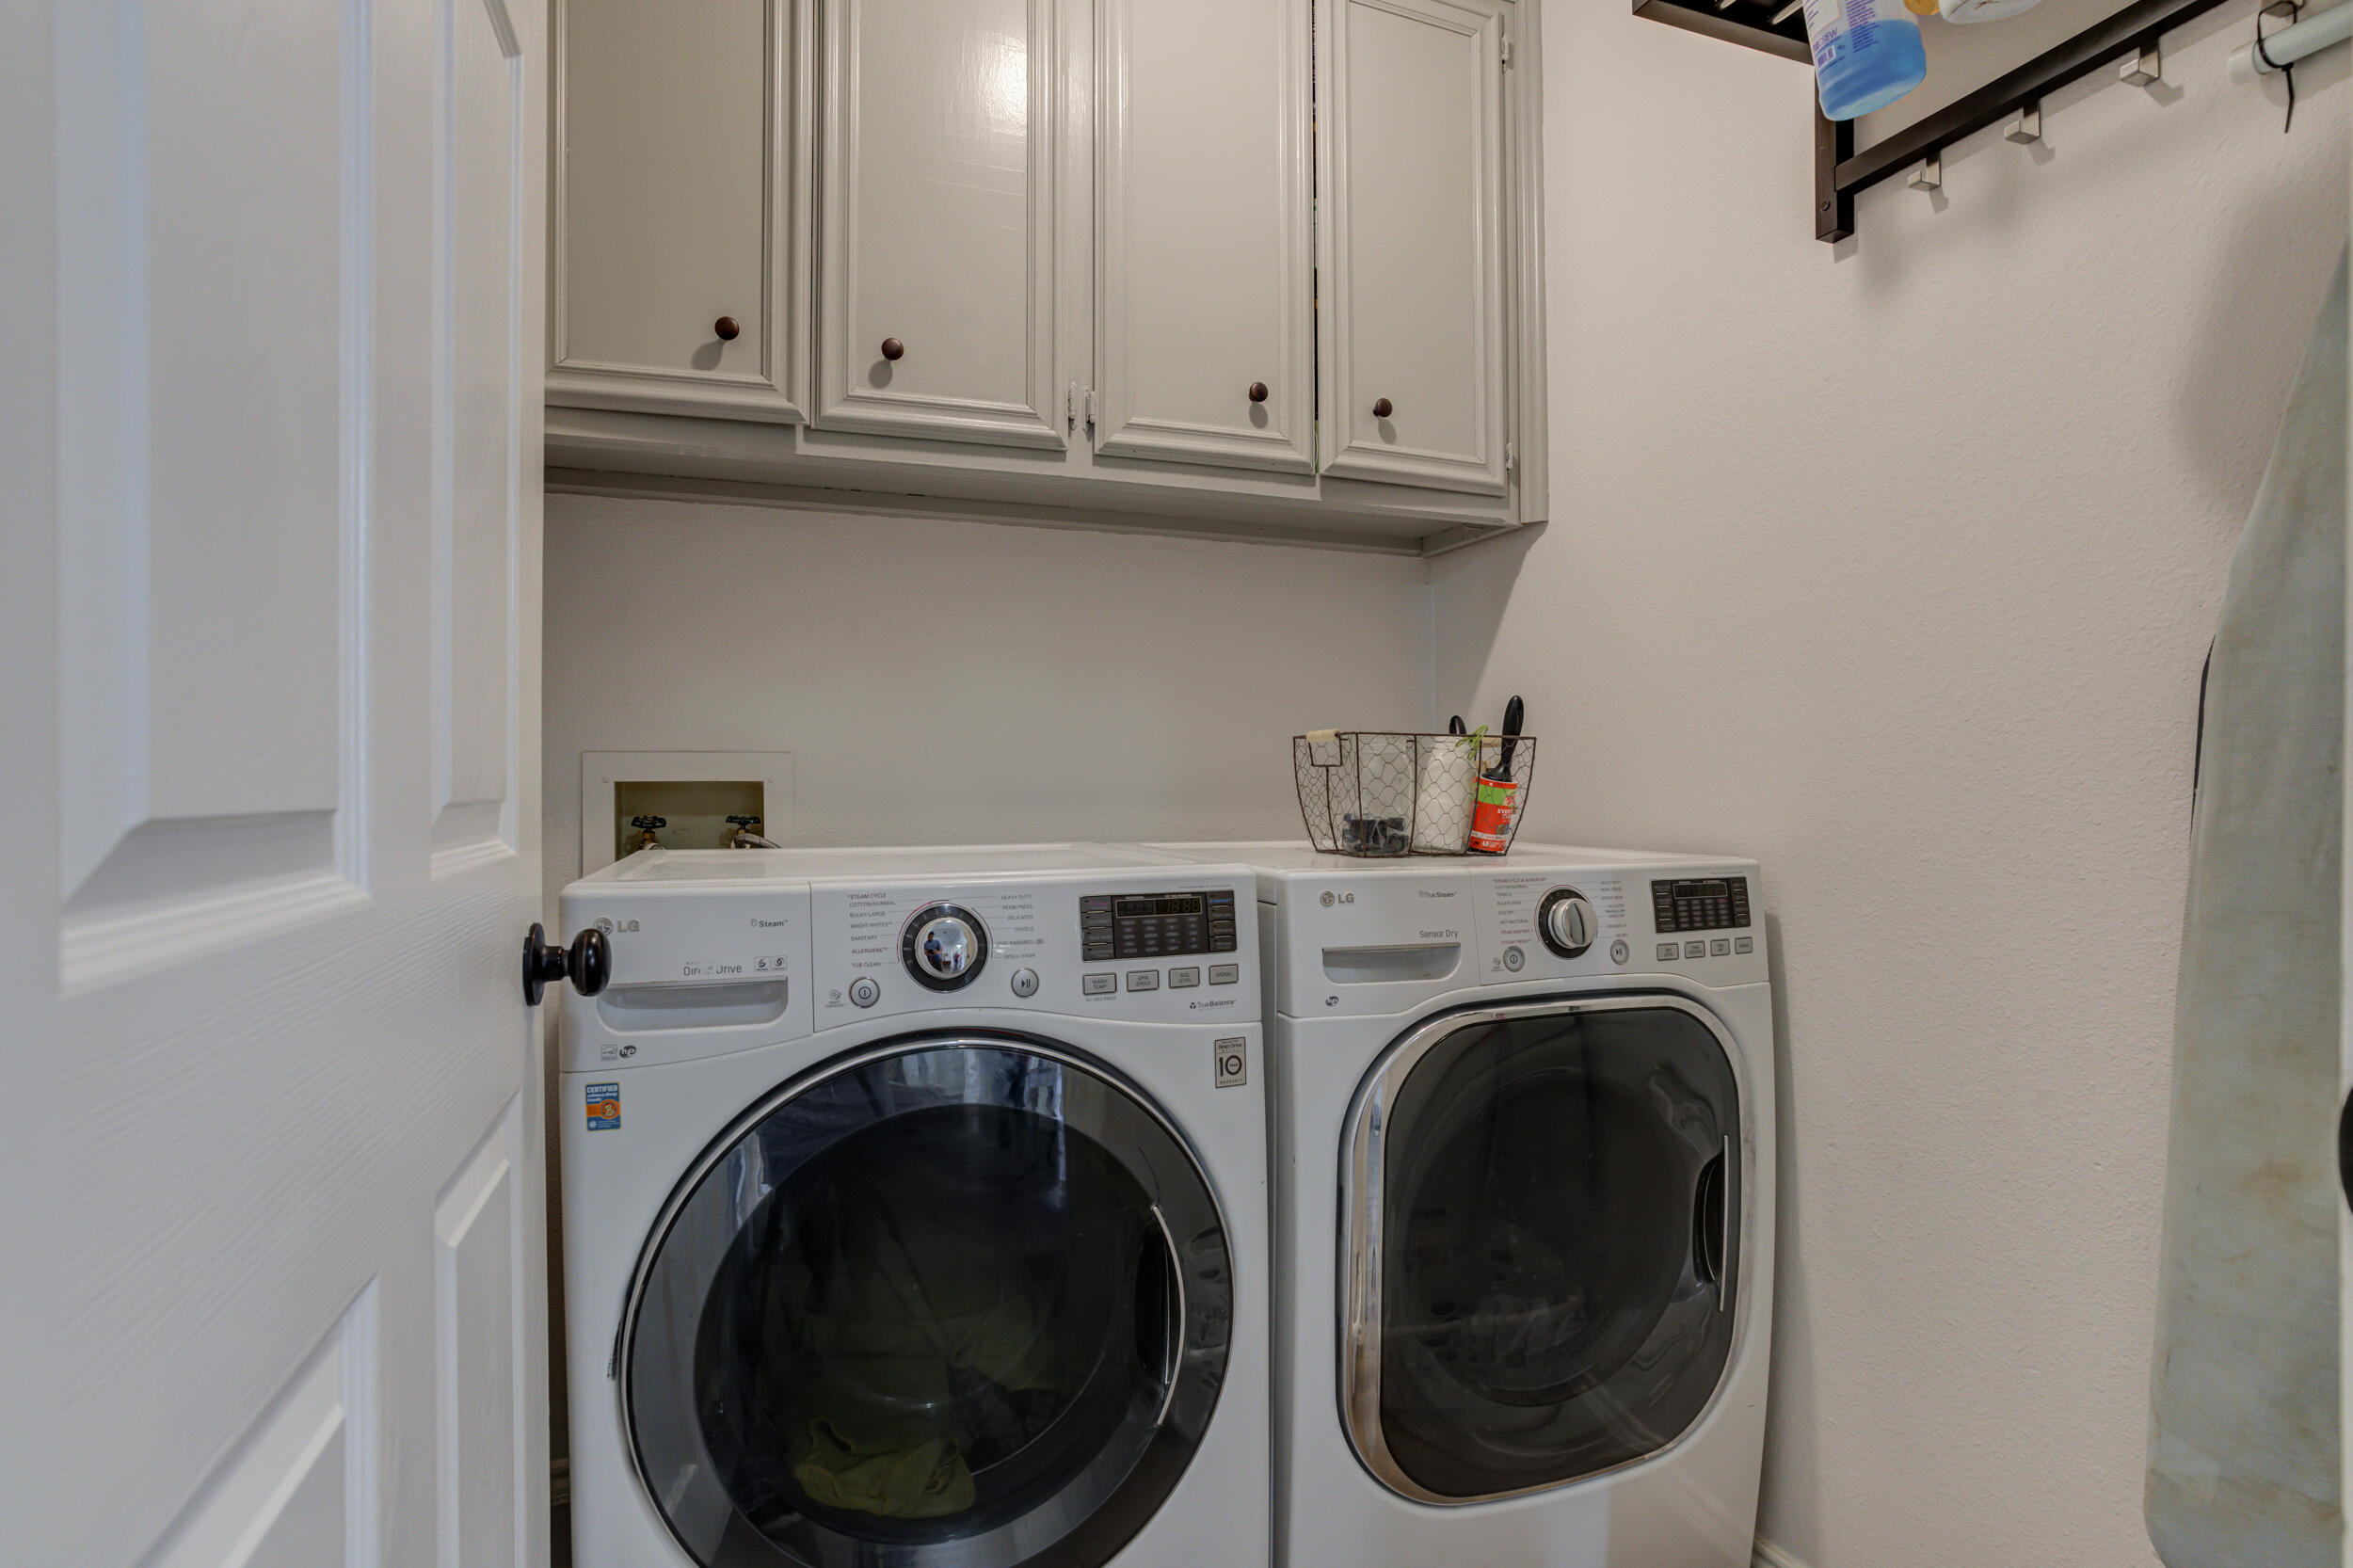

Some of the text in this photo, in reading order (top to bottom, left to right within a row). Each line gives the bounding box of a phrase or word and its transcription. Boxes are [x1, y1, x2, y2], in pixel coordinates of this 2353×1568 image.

[1337, 892, 1354, 904] LG
[617, 919, 640, 933] LG
[1419, 929, 1458, 939] Sensor Dry
[1219, 1055, 1242, 1077] 10
